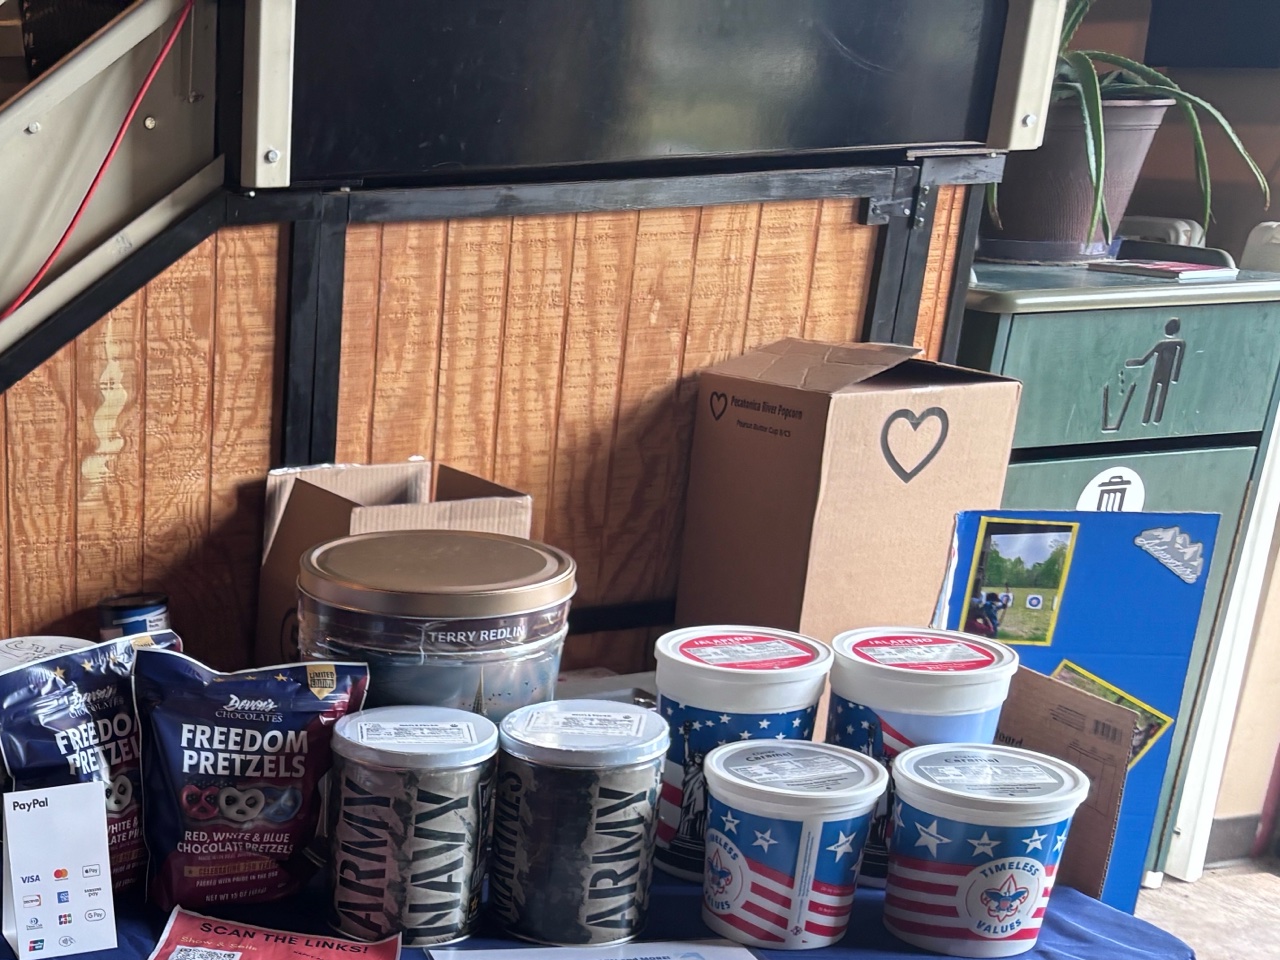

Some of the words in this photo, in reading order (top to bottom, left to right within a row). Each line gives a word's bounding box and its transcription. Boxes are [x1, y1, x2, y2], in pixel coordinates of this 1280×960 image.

[731, 395, 761, 412] Pecatonica
[762, 401, 777, 414] River
[778, 405, 803, 420] Popcorn
[428, 631, 477, 643] TERRY
[480, 627, 525, 641] REDLIN
[310, 670, 335, 680] LIMITED
[310, 679, 335, 689] EDITION
[215, 711, 283, 723] CHOCOLATES
[55, 713, 139, 755] FREEDO
[181, 723, 309, 754] FREEDOM
[182, 750, 306, 778] PRETZELS
[746, 751, 794, 763] Caramel
[944, 756, 1000, 764] Caramel
[13, 797, 48, 812] PayPal
[185, 831, 210, 844] RED,
[213, 832, 251, 842] WHITE
[252, 832, 261, 842] &
[263, 832, 290, 843] BLUE
[177, 842, 243, 854] CHOCOLATE
[245, 843, 294, 854] PRETZELS
[335, 776, 391, 935] ARMY
[407, 788, 470, 938] NAVY
[585, 786, 648, 931] ARMY
[979, 861, 1039, 878] TIMELESS
[21, 875, 40, 884] VISA
[206, 894, 217, 902] NET
[219, 893, 229, 901] WT
[93, 911, 103, 919] Pay
[976, 918, 1021, 935] VALUES
[180, 936, 210, 946] Show
[200, 922, 256, 939] SCAN
[263, 933, 299, 946] THE
[304, 938, 368, 954] LINKS!
